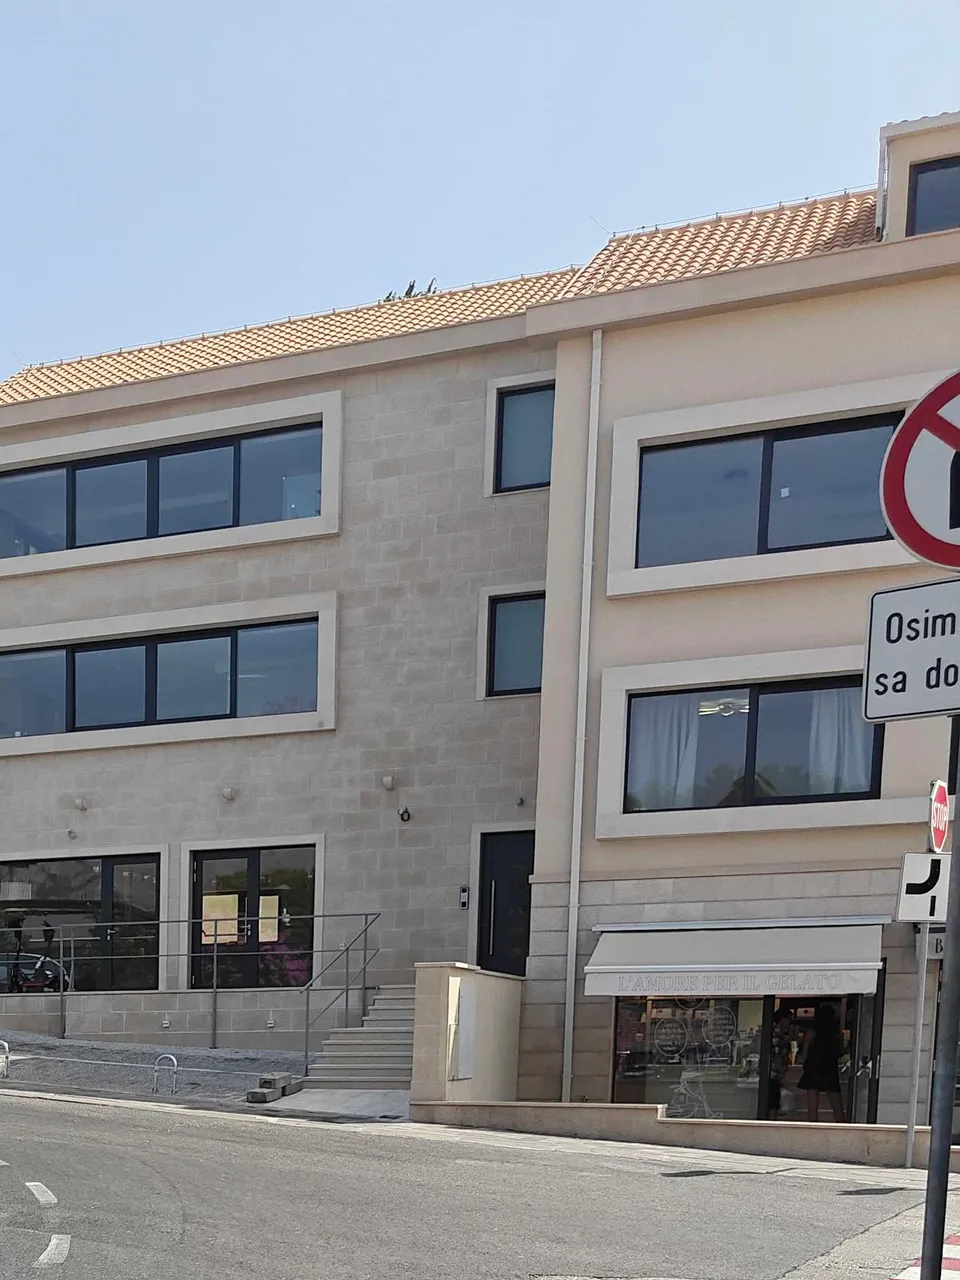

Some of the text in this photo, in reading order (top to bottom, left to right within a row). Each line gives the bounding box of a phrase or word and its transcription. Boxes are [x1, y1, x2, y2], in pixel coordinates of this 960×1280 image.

[886, 609, 957, 645] Osim
[874, 670, 908, 697] sa
[932, 803, 949, 832] STOP
[617, 974, 841, 992] L'AMORE PER IL GELATO
